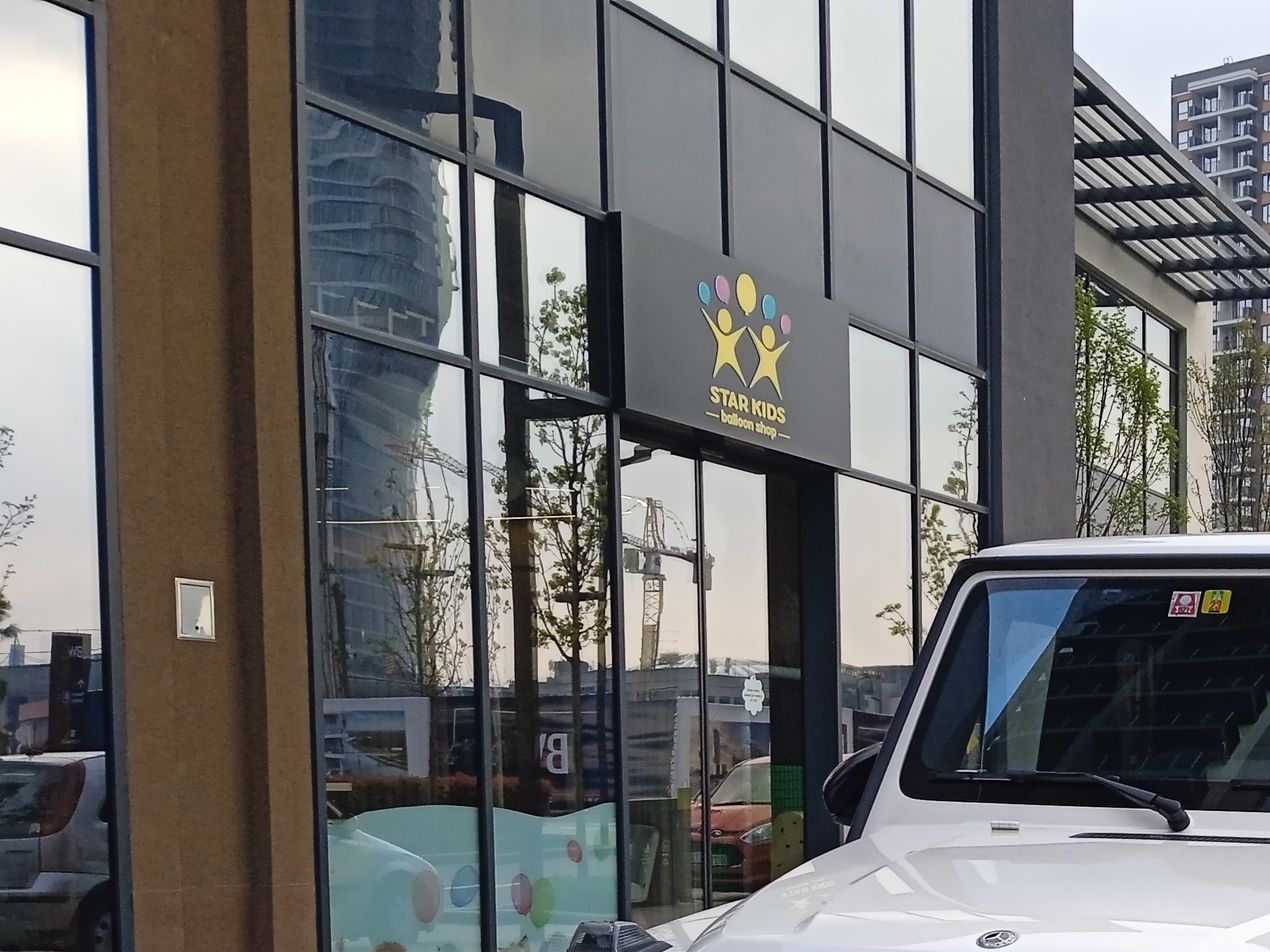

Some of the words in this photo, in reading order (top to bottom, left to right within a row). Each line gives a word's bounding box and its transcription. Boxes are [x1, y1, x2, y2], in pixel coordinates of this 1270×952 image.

[710, 385, 749, 413] STAR
[751, 398, 786, 424] KIDS
[720, 409, 754, 431] balloon
[755, 421, 776, 440] shop
[1208, 600, 1222, 611] 23
